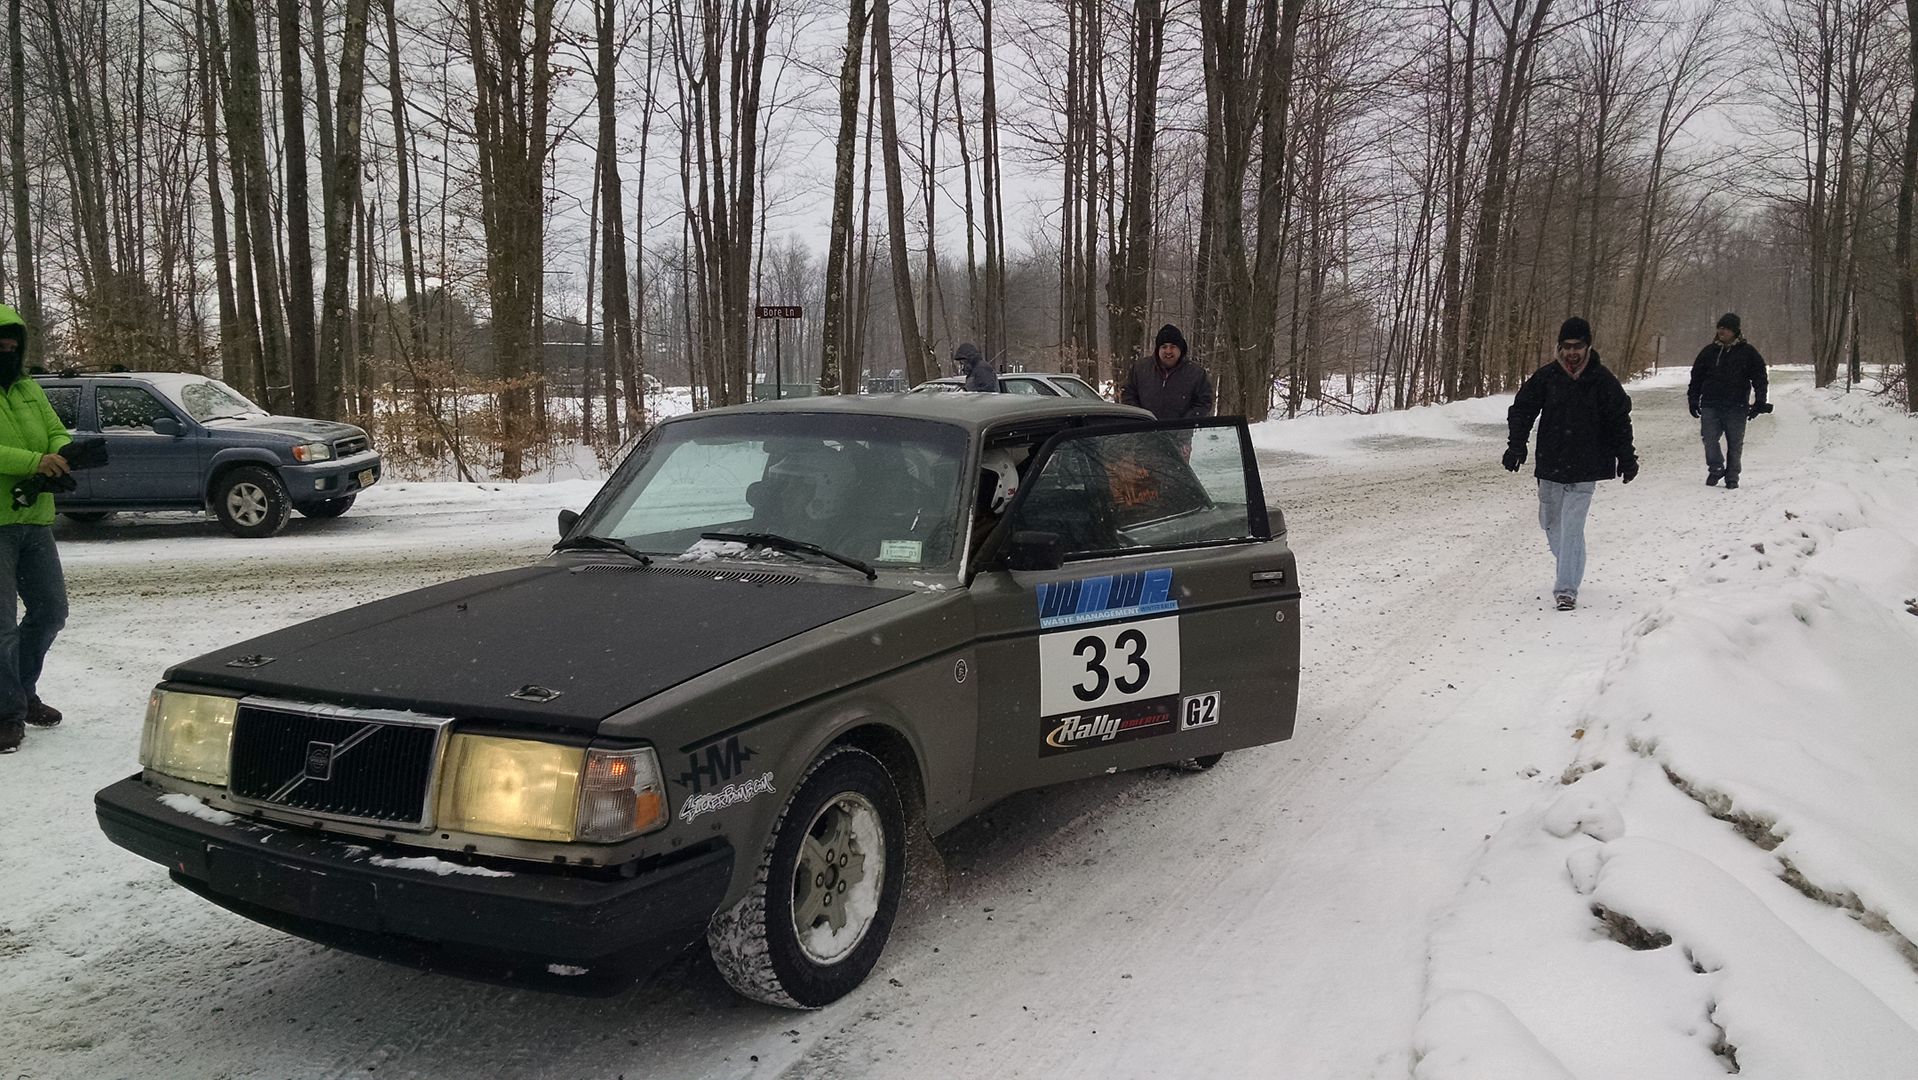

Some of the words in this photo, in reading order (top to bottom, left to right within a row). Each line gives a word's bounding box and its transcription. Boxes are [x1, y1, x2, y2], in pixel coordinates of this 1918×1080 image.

[763, 307, 783, 317] Bore
[785, 307, 795, 317] Ln
[1042, 614, 1075, 627] WASTE
[1076, 608, 1140, 623] MANAGEMENT
[1072, 629, 1151, 702] 33
[1187, 695, 1217, 726] G2
[1058, 714, 1121, 744] Rally
